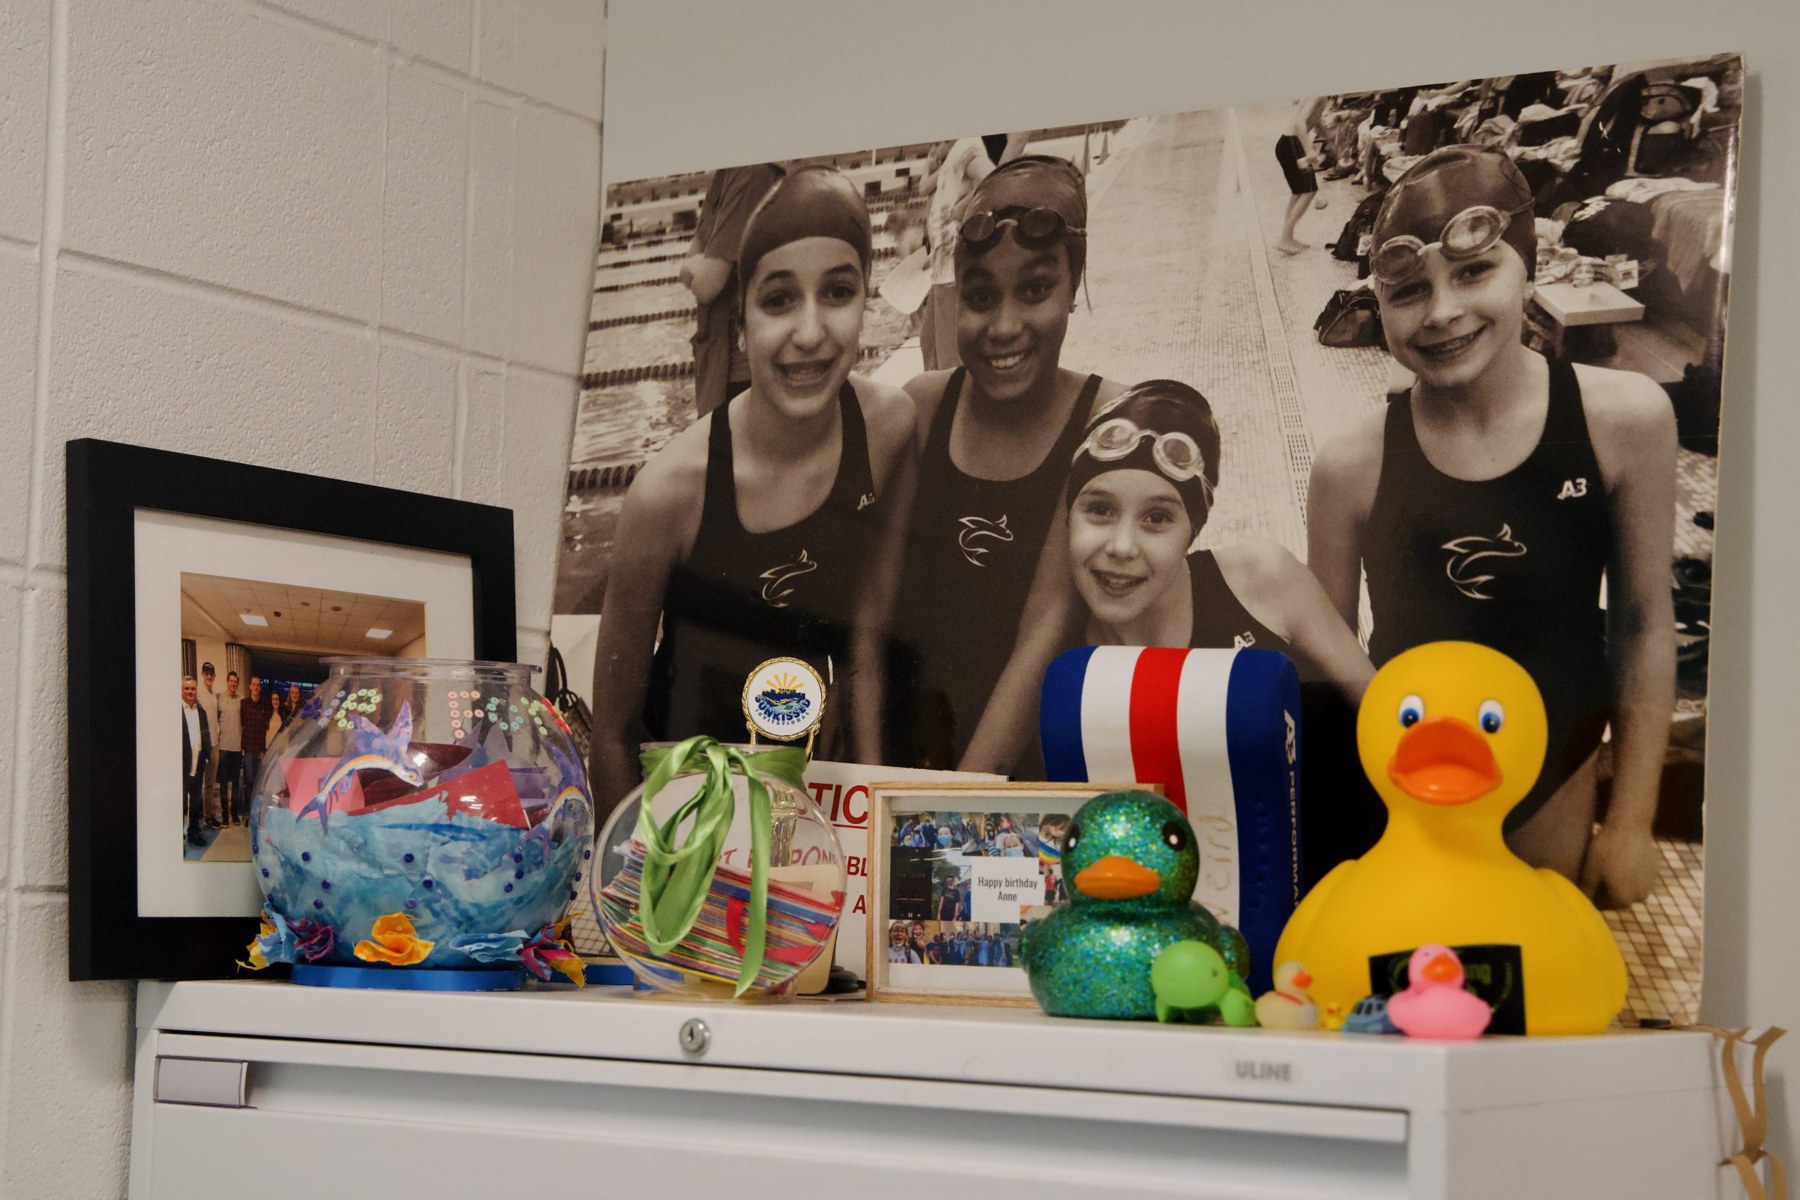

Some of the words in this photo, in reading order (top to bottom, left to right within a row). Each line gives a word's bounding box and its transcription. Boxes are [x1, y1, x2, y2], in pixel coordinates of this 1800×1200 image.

[1557, 478, 1587, 500] A3
[755, 696, 811, 721] SUNKISSED
[978, 877, 1003, 889] Happy
[1005, 878, 1038, 889] birthday
[998, 891, 1018, 901] Anne
[1235, 1060, 1291, 1082] ULINE
